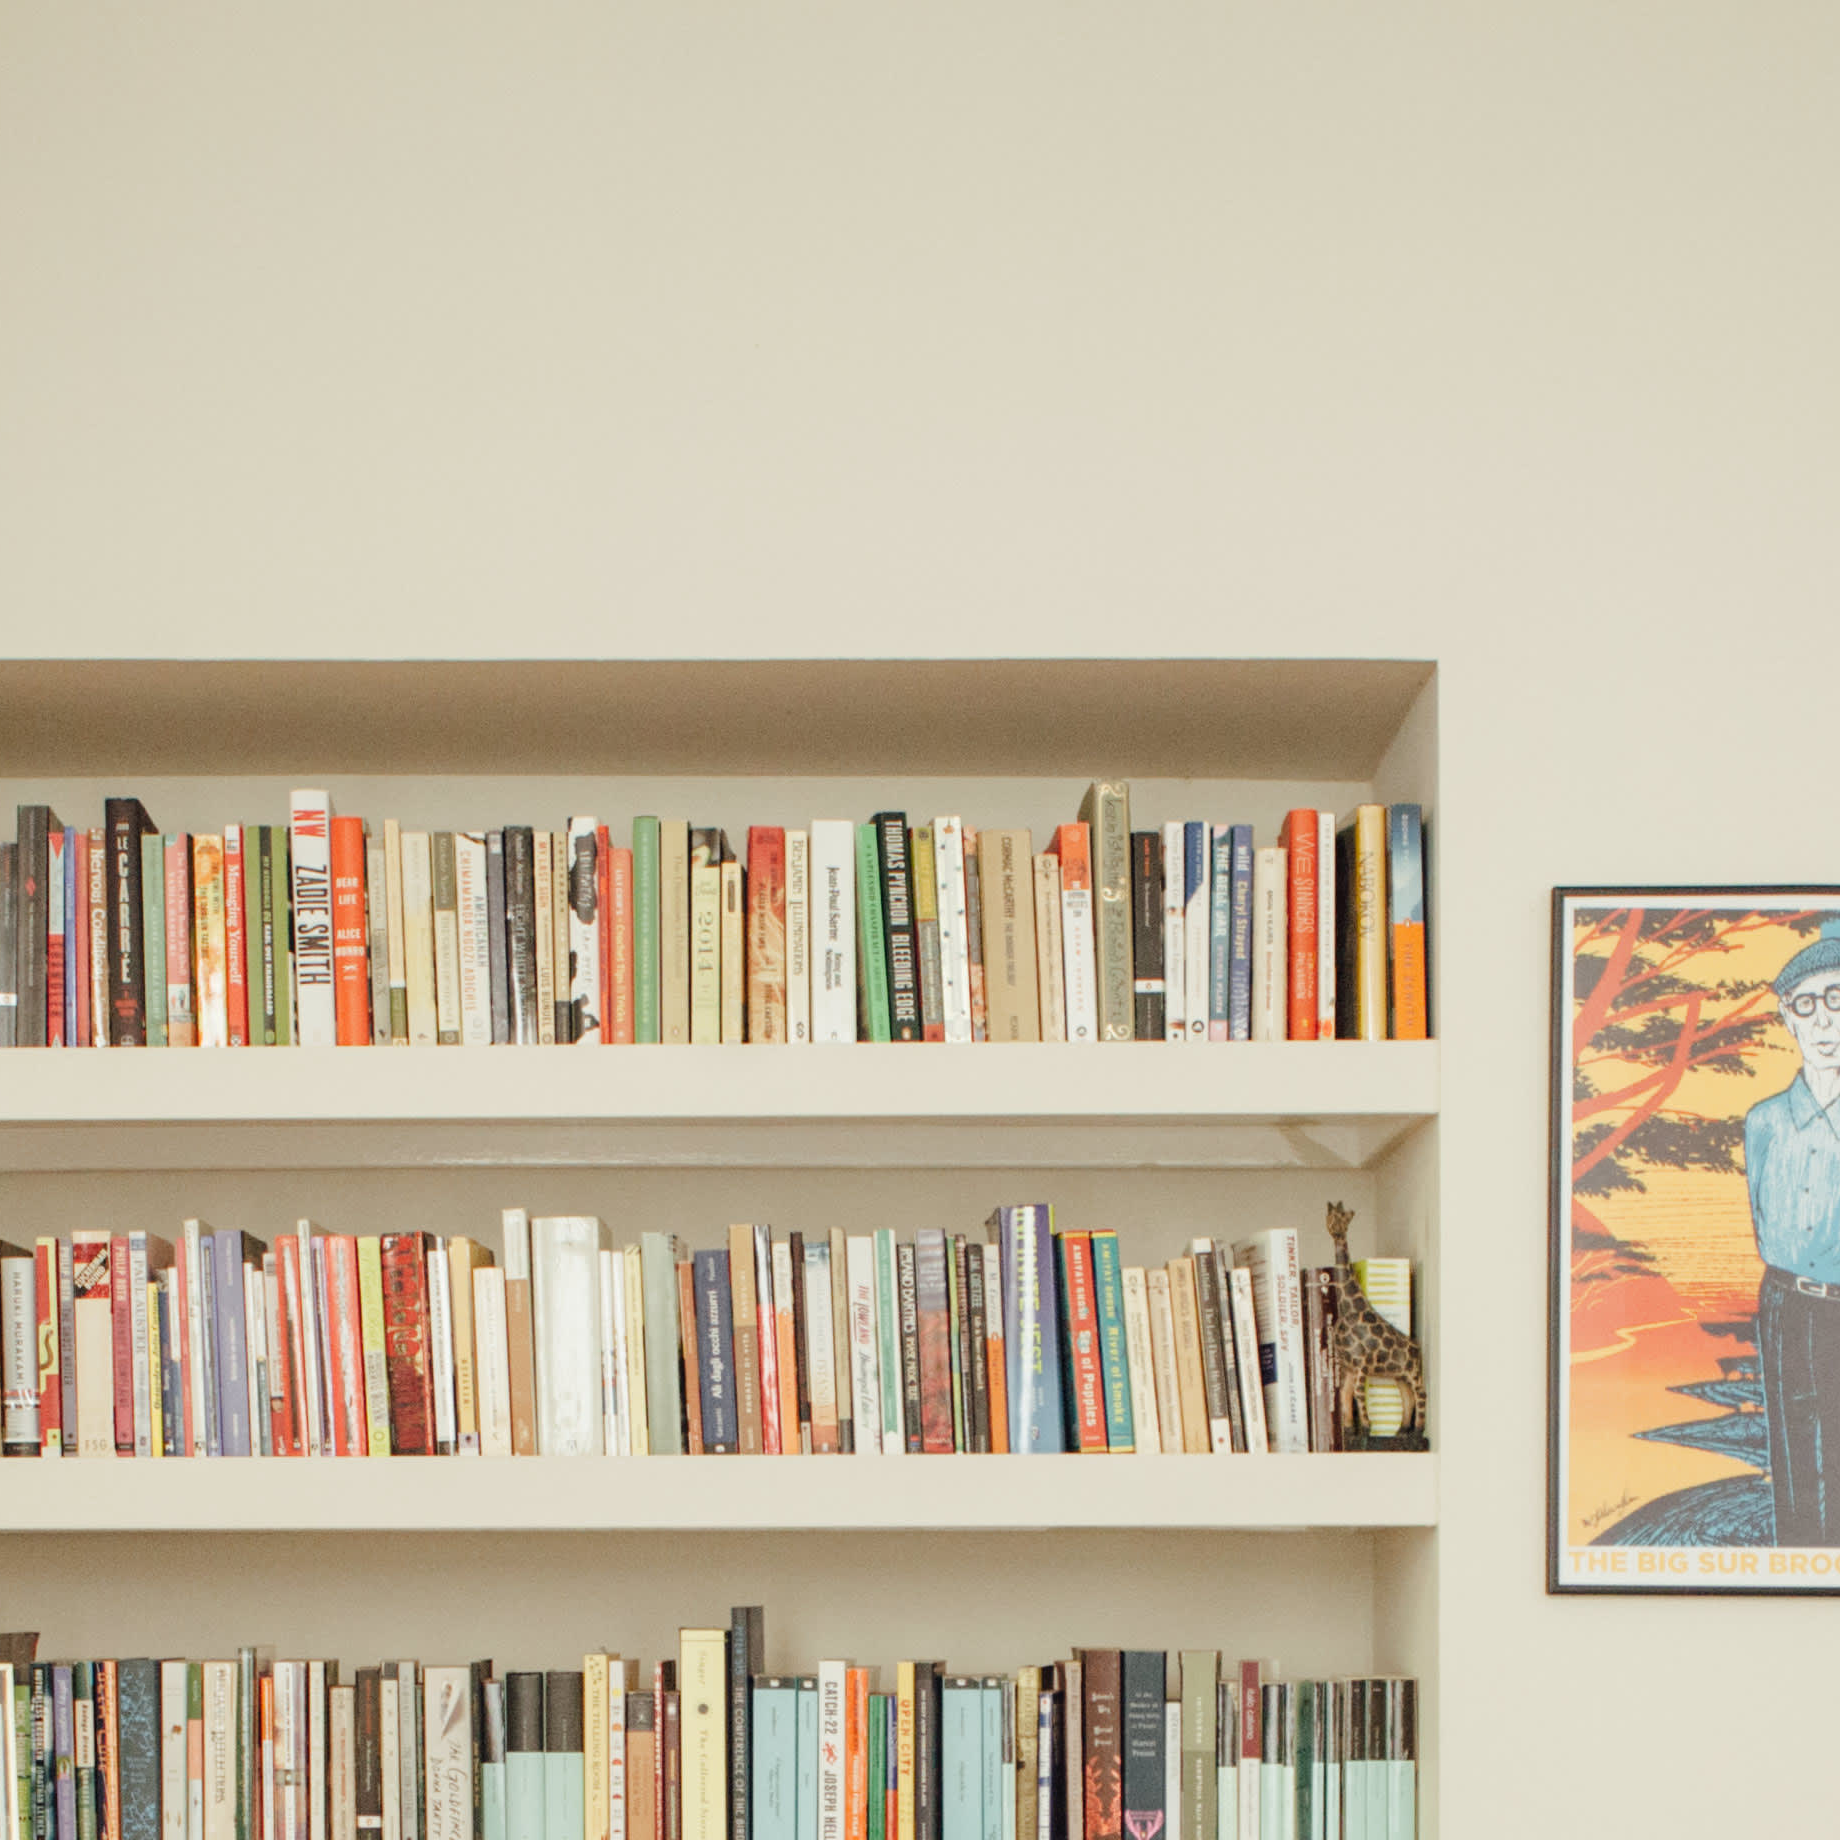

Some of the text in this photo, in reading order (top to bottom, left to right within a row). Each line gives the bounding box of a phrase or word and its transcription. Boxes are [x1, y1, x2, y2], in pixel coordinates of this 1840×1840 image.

[293, 810, 327, 838] NW
[335, 877, 359, 889] DEAR
[460, 850, 474, 925] CHIMAMANDA
[885, 820, 909, 925] THOMAS PYNCHON
[1001, 837, 1015, 918] CORMAC McCARTHY
[1237, 846, 1250, 871] wild
[1294, 833, 1315, 934] WE SINNERS
[89, 848, 108, 981] Nervous Conditions
[338, 894, 358, 905] LIFE
[1216, 845, 1228, 937] THE BELL JAR
[1234, 881, 1249, 959] Cheryl Strayed
[1359, 851, 1376, 940] NABOKOV
[226, 864, 243, 985] Managing Yourself
[295, 864, 331, 985] ZADIE SMITH
[336, 928, 362, 940] ALICE
[462, 930, 475, 963] NGOZI
[474, 896, 487, 967] AMERICANAH
[514, 904, 526, 938] EIGHT
[697, 911, 714, 976] 2014
[828, 912, 840, 941] Sartre
[377, 983, 390, 997] X
[540, 967, 550, 988] LUIS
[891, 934, 915, 1022] BLEEDING EDGE
[901, 1247, 913, 1285] ROLAND
[1287, 1235, 1300, 1329] TINKER, TAILOR,
[12, 1271, 25, 1386] HARUKI MURAKAMI
[134, 1260, 145, 1354] PAUL AUSTER
[854, 1302, 871, 1344] LOWLAND
[709, 1325, 721, 1356] occhi
[710, 1357, 724, 1382] dagli
[1280, 1329, 1289, 1352] SPY
[712, 1383, 723, 1399] Ali
[1077, 1330, 1098, 1426] Sea of Poppies
[1109, 1327, 1126, 1423] River of Smoke
[1567, 1550, 1627, 1573] THE
[1637, 1551, 1693, 1574] BIG
[1698, 1551, 1760, 1575] SUR
[735, 1686, 745, 1706] THE
[825, 1681, 839, 1735] CATCH-22
[592, 1688, 601, 1791] THE TELLING ROOM
[735, 1708, 745, 1775] CONFERENCE
[900, 1699, 912, 1776] OPEN CITY
[430, 1757, 442, 1838] DONNA TARTT
[735, 1779, 745, 1793] OF
[735, 1796, 745, 1815] THE
[825, 1770, 839, 1812] JOSEPH
